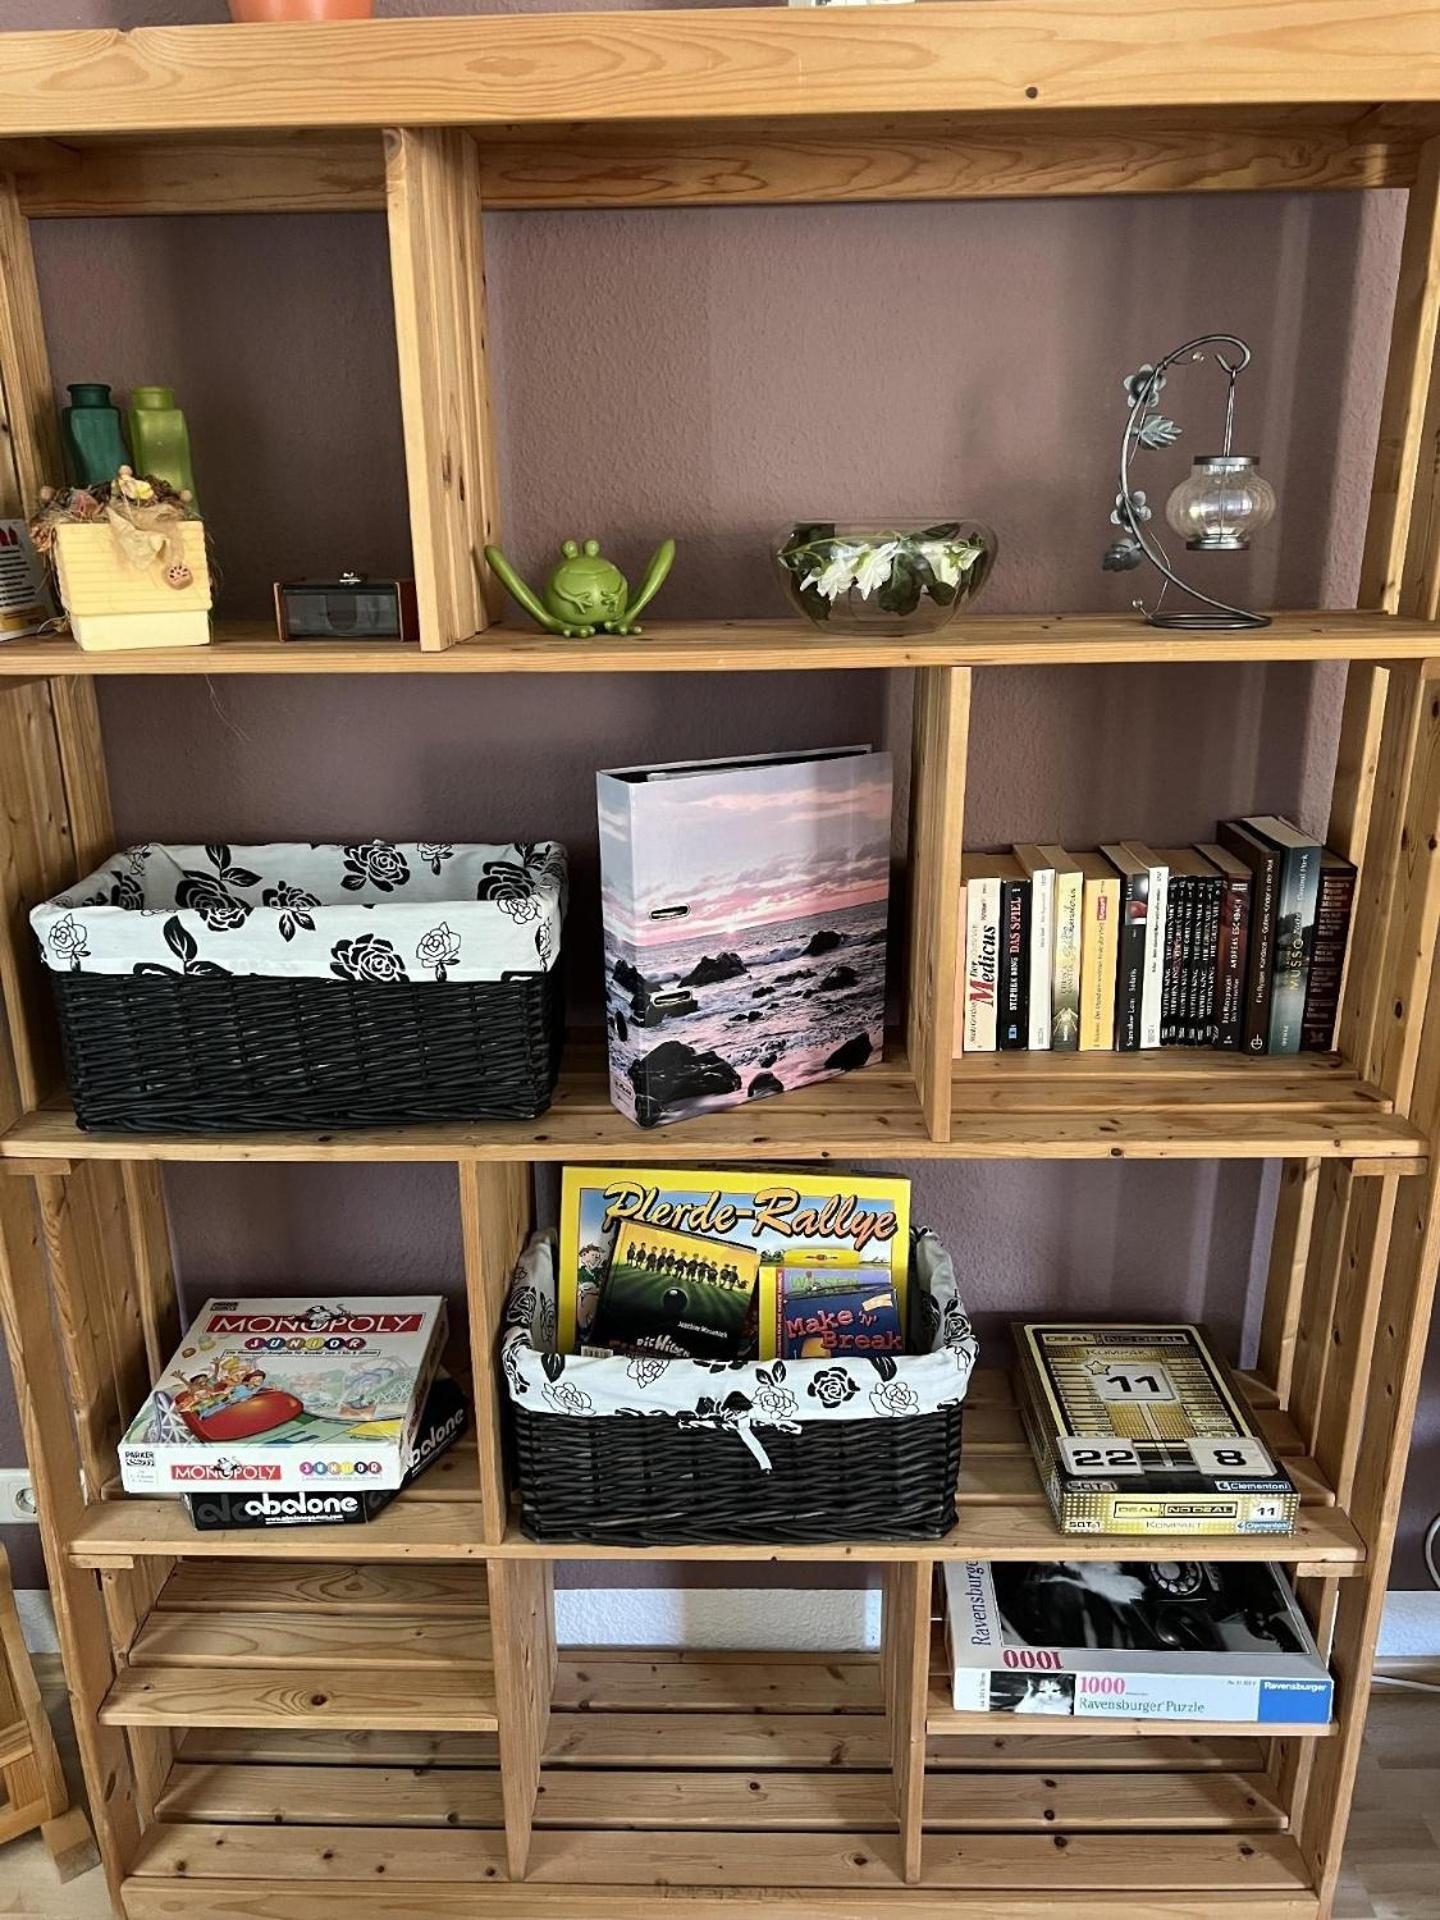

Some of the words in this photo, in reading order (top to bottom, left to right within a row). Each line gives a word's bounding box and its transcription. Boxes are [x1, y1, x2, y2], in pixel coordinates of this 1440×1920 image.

[1009, 896, 1021, 930] SPIEL
[1009, 932, 1020, 954] DAS
[1230, 937, 1240, 969] ANDREAS
[969, 925, 996, 1008] Medicus
[1290, 938, 1304, 991] MUSSO
[1128, 968, 1138, 992] Solaris
[213, 1315, 413, 1332] MONOPOLY
[785, 1309, 853, 1338] Make
[247, 1338, 363, 1349] JUNIOR
[820, 1331, 903, 1350] Break
[1106, 1376, 1160, 1392] 11
[408, 1408, 464, 1467] balone
[1072, 1450, 1138, 1466] 22
[1213, 1450, 1247, 1466] 8
[174, 1466, 276, 1480] MONOPOLY
[301, 1462, 380, 1474] JUNIOR
[1230, 1481, 1289, 1491] Clementoni
[244, 1492, 358, 1516] abalone
[1117, 1505, 1159, 1513] DEAL
[1167, 1505, 1191, 1514] NO
[1192, 1505, 1234, 1514] DEAL
[1257, 1507, 1276, 1516] 11
[1003, 1650, 1064, 1669] 1000
[1080, 1677, 1126, 1695] 1000
[1264, 1681, 1327, 1692] Ravensburger
[1080, 1698, 1161, 1713] Ravensburger
[1165, 1700, 1205, 1713] Puzzle
